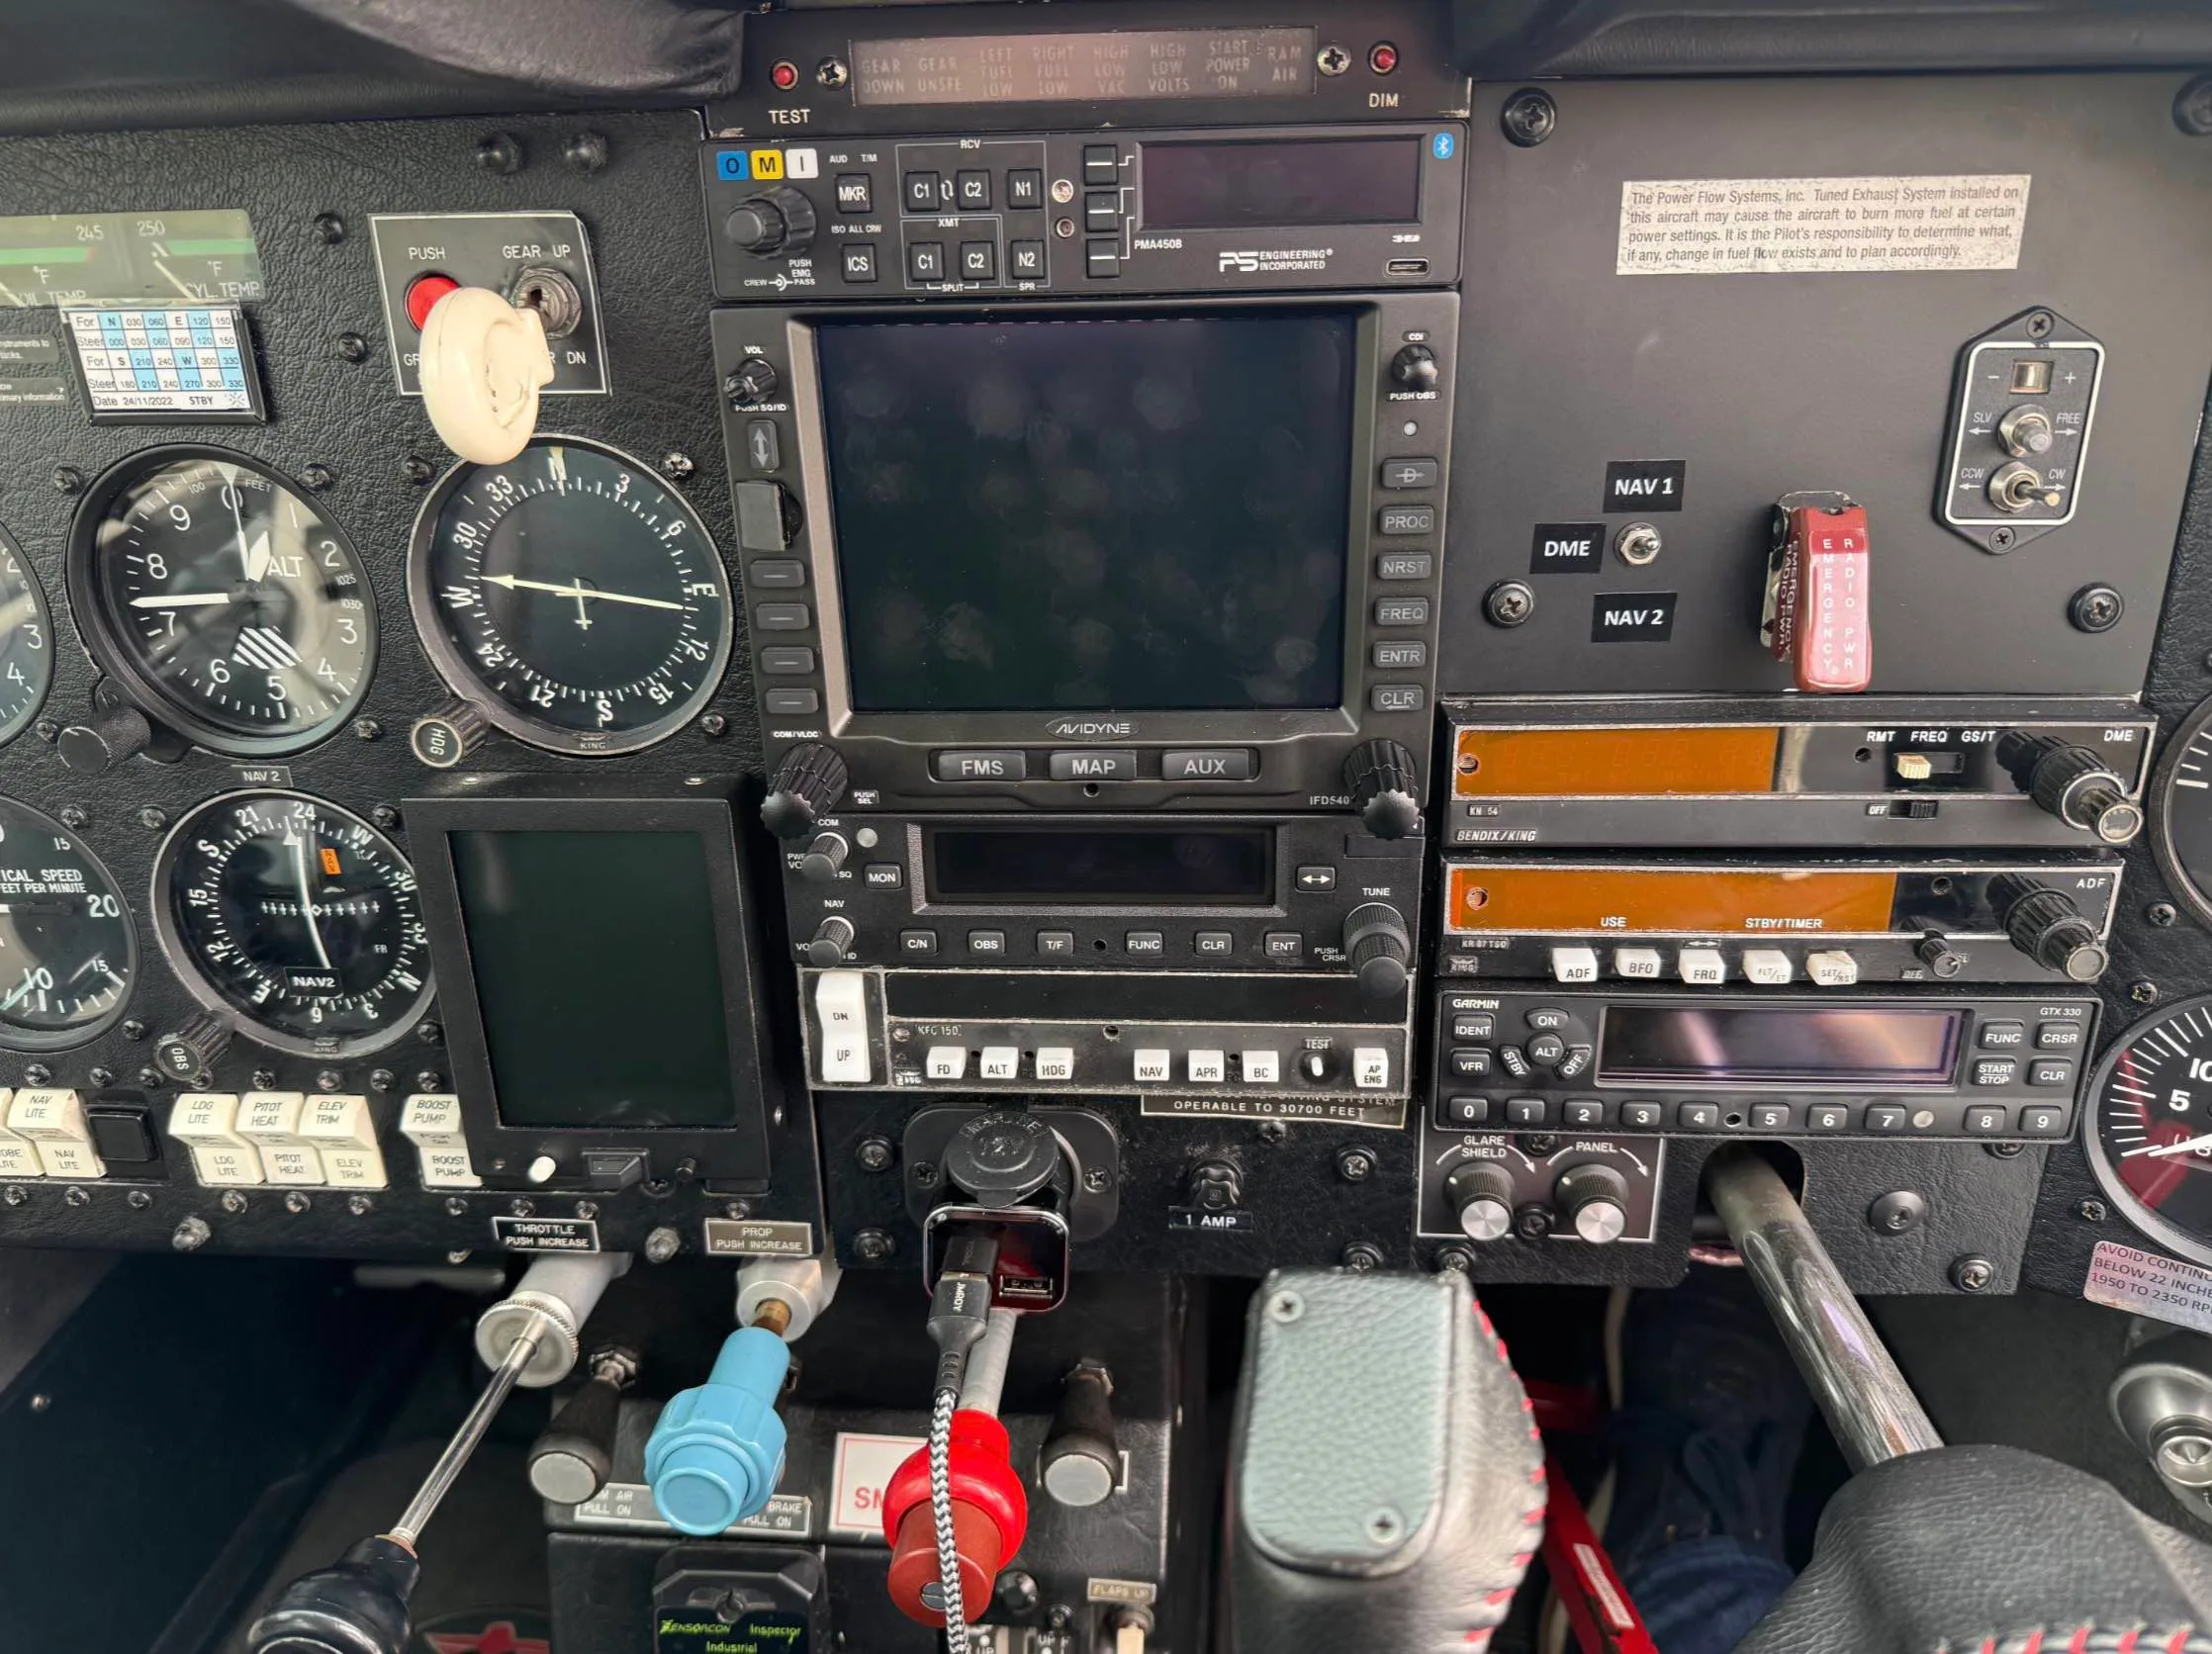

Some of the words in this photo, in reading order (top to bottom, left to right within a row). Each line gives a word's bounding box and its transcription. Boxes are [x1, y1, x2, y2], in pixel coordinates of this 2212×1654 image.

[1209, 40, 1247, 55] START
[1206, 57, 1250, 73] POWER
[1218, 75, 1238, 91] ON
[1369, 93, 1398, 108] DIM
[769, 109, 810, 124] TEST
[759, 157, 776, 172] M
[799, 155, 805, 171] I
[839, 186, 867, 200] MKR
[914, 184, 930, 198] C1
[966, 183, 981, 197] C2
[1016, 182, 1032, 196] N1
[1632, 192, 1652, 204] The
[1657, 192, 1694, 204] Power
[1698, 191, 1725, 203] Flow
[1814, 189, 1848, 201] Tuned
[1853, 188, 1897, 201] Exhaust
[1902, 188, 1945, 202] System
[1950, 187, 1999, 199] installed
[2004, 189, 2018, 198] on
[137, 221, 165, 236] 250
[939, 219, 959, 228] XMT
[76, 225, 104, 241] 245
[1134, 238, 1183, 250] PMA450B
[409, 246, 445, 260] PUSH
[503, 244, 541, 258] GEAR
[553, 244, 570, 257] UP
[1627, 249, 1635, 261] if
[1666, 248, 1708, 262] change
[1713, 248, 1723, 259] in
[1727, 247, 1750, 259] fuel
[1754, 247, 1777, 258] flow
[1782, 246, 1816, 257] exists
[1820, 246, 1842, 258] and
[1847, 247, 1857, 258] to
[1862, 245, 1887, 259] plan
[1890, 244, 1961, 258] accordingly.
[848, 256, 869, 271] ICS
[1019, 253, 1035, 267] N2
[1259, 259, 1326, 271] INCORPORATED
[567, 351, 586, 365] DN
[94, 397, 118, 407] Date
[123, 397, 173, 406] 24/11/2022
[1973, 413, 1991, 422] SLV
[2057, 414, 2080, 423] FREE
[245, 479, 271, 493] FEET
[487, 475, 513, 501] 33
[1614, 479, 1658, 495] NAV
[1662, 478, 1674, 494] 1
[1385, 515, 1429, 528] PROC
[1544, 541, 1591, 557] DME
[267, 557, 303, 578] ALT
[1384, 561, 1426, 574] NRST
[1381, 608, 1425, 619] FREQ
[1605, 610, 1647, 625] NAV
[1651, 609, 1664, 624] 2
[1379, 651, 1421, 662] ENTR
[1380, 692, 1415, 705] CLR
[1056, 723, 1130, 734] AVIDYNE
[1867, 731, 1895, 741] RMT
[1910, 731, 1948, 742] FREQ
[1961, 731, 1996, 742] GS/T
[2104, 730, 2133, 741] DME
[430, 728, 445, 755] HDG
[962, 761, 1004, 776] FMS
[1072, 760, 1116, 775] MAP
[1184, 760, 1226, 775] AUX
[243, 771, 268, 781] NAV
[272, 771, 281, 781] 2
[1310, 795, 1349, 805] IFD540
[1457, 830, 1536, 841] BENDIX/KING
[41, 870, 82, 881] SPEED
[869, 873, 895, 882] MON
[24, 883, 46, 893] PER
[49, 883, 87, 893] MINUTE
[2076, 878, 2105, 888] ADF
[87, 894, 120, 918] 20
[1601, 917, 1626, 927] USE
[1745, 918, 1821, 929] STBY/TIMER
[907, 939, 928, 949] C/N
[973, 940, 998, 950] OBS
[1129, 940, 1159, 950] FUNC
[1272, 942, 1295, 951] ENT
[1566, 968, 1590, 978] ADF
[1629, 963, 1653, 973] BFO
[1694, 969, 1716, 979] FRQ
[293, 976, 335, 987] NAV2
[1452, 999, 1499, 1009] GARMIN
[2040, 1007, 2061, 1016] GTX
[2063, 1007, 2081, 1016] 330
[1537, 1016, 1557, 1027] ON
[1455, 1026, 1490, 1036] IDENT
[1985, 1034, 2021, 1044] FUNC
[2042, 1034, 2077, 1044] CRSR
[1535, 1048, 1557, 1057] ALT
[171, 1048, 189, 1070] OBS
[937, 1064, 950, 1074] FD
[987, 1064, 1008, 1074] ALT
[1042, 1064, 1065, 1075] HDG
[1140, 1066, 1162, 1076] NAV
[1460, 1061, 1483, 1071] VFR
[1979, 1064, 2014, 1074] START
[1196, 1067, 1217, 1077] APR
[1253, 1067, 1268, 1078] BC
[2040, 1070, 2065, 1080] CLR
[1979, 1075, 2009, 1084] STOP
[253, 1101, 282, 1112] PITOT
[318, 1101, 347, 1111] ELEV
[416, 1100, 451, 1110] BOOST
[1174, 1100, 1246, 1111] OPERABLE
[1254, 1102, 1271, 1112] TO
[1280, 1103, 1322, 1114] 30700
[1330, 1106, 1364, 1116] FEET
[25, 1109, 46, 1118] LITE
[413, 1113, 447, 1124] PUMP
[251, 1115, 279, 1126] HEAT
[316, 1114, 339, 1125] TRIM
[1464, 1136, 1506, 1147] GLARE
[1461, 1148, 1507, 1158] SHIELD
[1576, 1143, 1617, 1152] PANEL
[1186, 1215, 1192, 1225] 1
[1201, 1216, 1237, 1227] AMP
[514, 1224, 576, 1235] THROTTLE
[742, 1227, 773, 1237] PROP
[506, 1237, 534, 1246] PUSH
[538, 1238, 589, 1247] INCREASE
[2097, 1242, 2144, 1262] AVOID
[2094, 1257, 2146, 1278] BELOW
[2149, 1272, 2166, 1285] 22
[2091, 1272, 2126, 1289] 1950
[2129, 1282, 2149, 1296] TO
[2152, 1290, 2188, 1306] 2350
[769, 1503, 801, 1513] BRAKE
[749, 1624, 801, 1642] Inspector
[706, 1641, 758, 1654] Industrial
